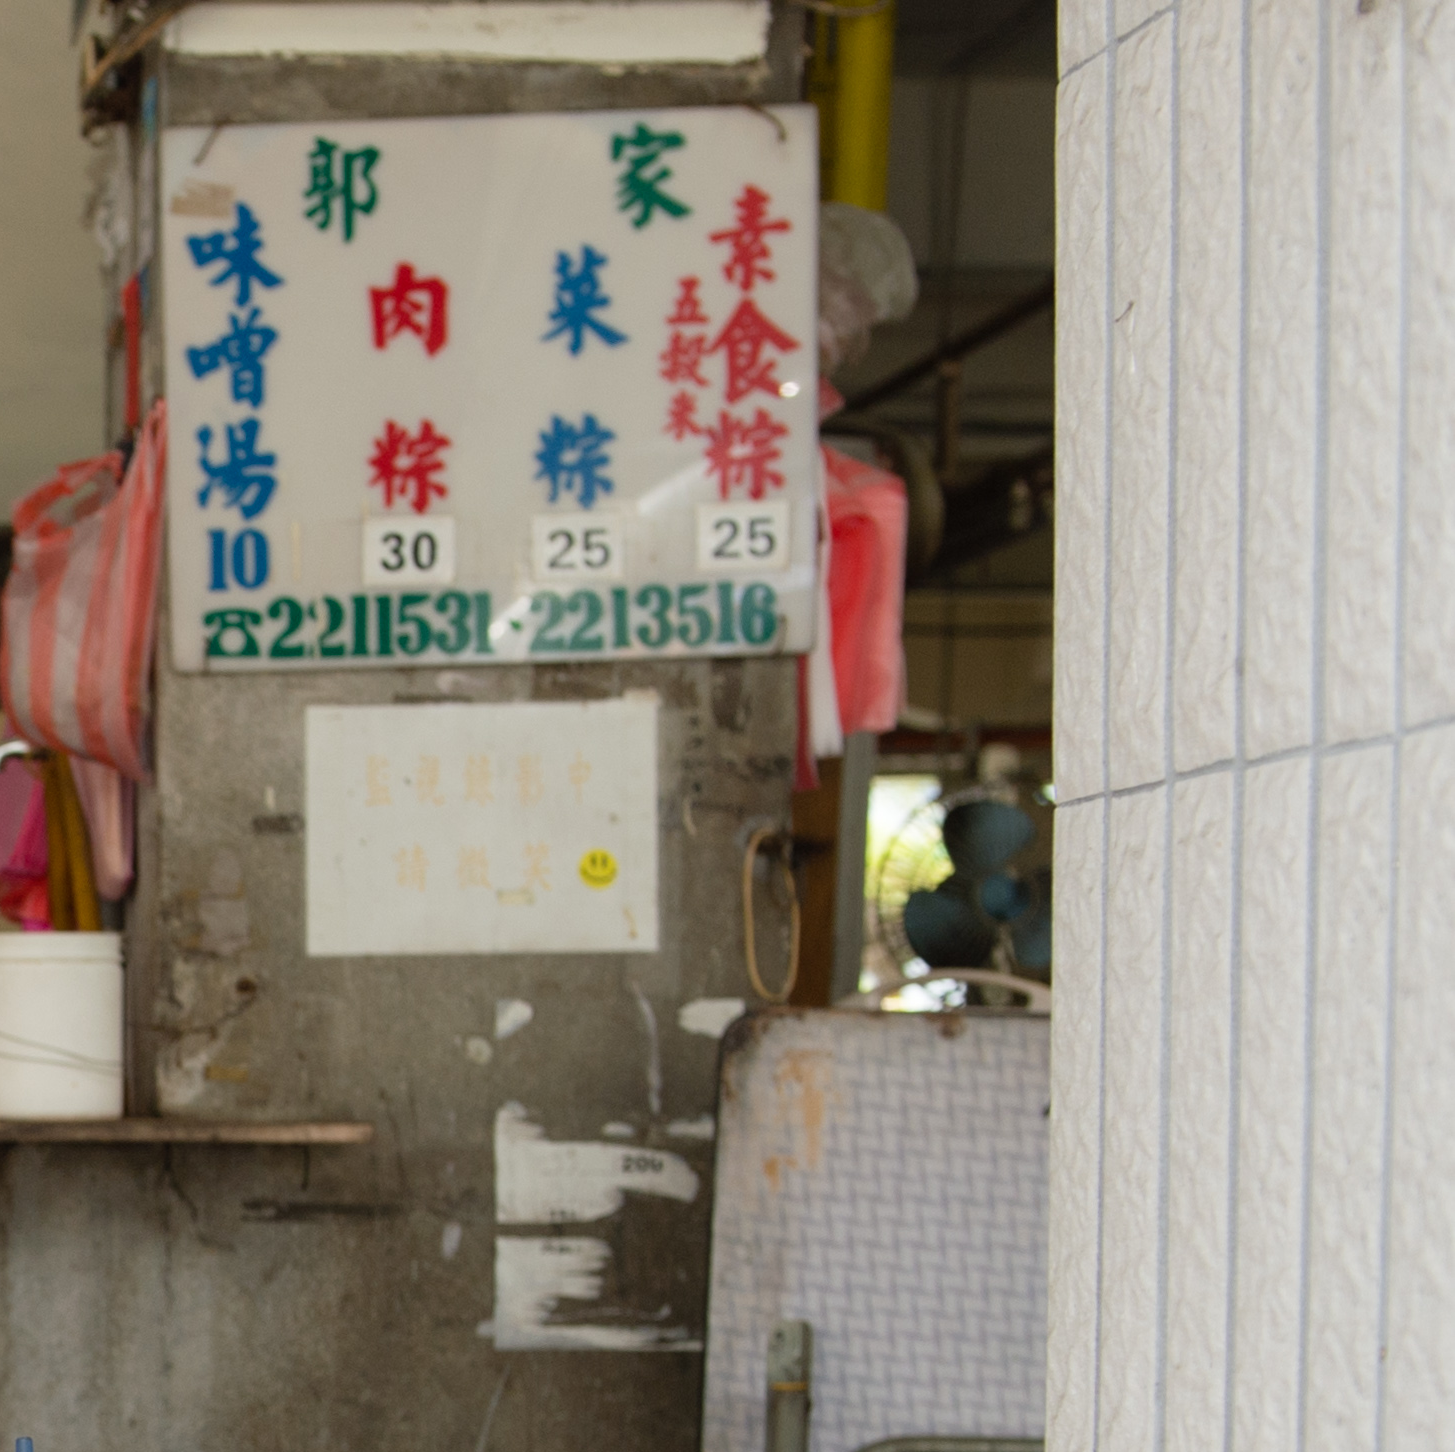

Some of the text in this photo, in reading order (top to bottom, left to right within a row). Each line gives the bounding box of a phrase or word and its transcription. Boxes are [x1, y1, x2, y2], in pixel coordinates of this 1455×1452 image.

[185, 201, 285, 521] 味噌湯
[703, 183, 801, 501] 素食粽
[367, 261, 451, 514] 肉粽
[208, 527, 270, 592] 10
[379, 531, 437, 571] 30
[546, 529, 611, 570] 25
[712, 518, 775, 558] 25
